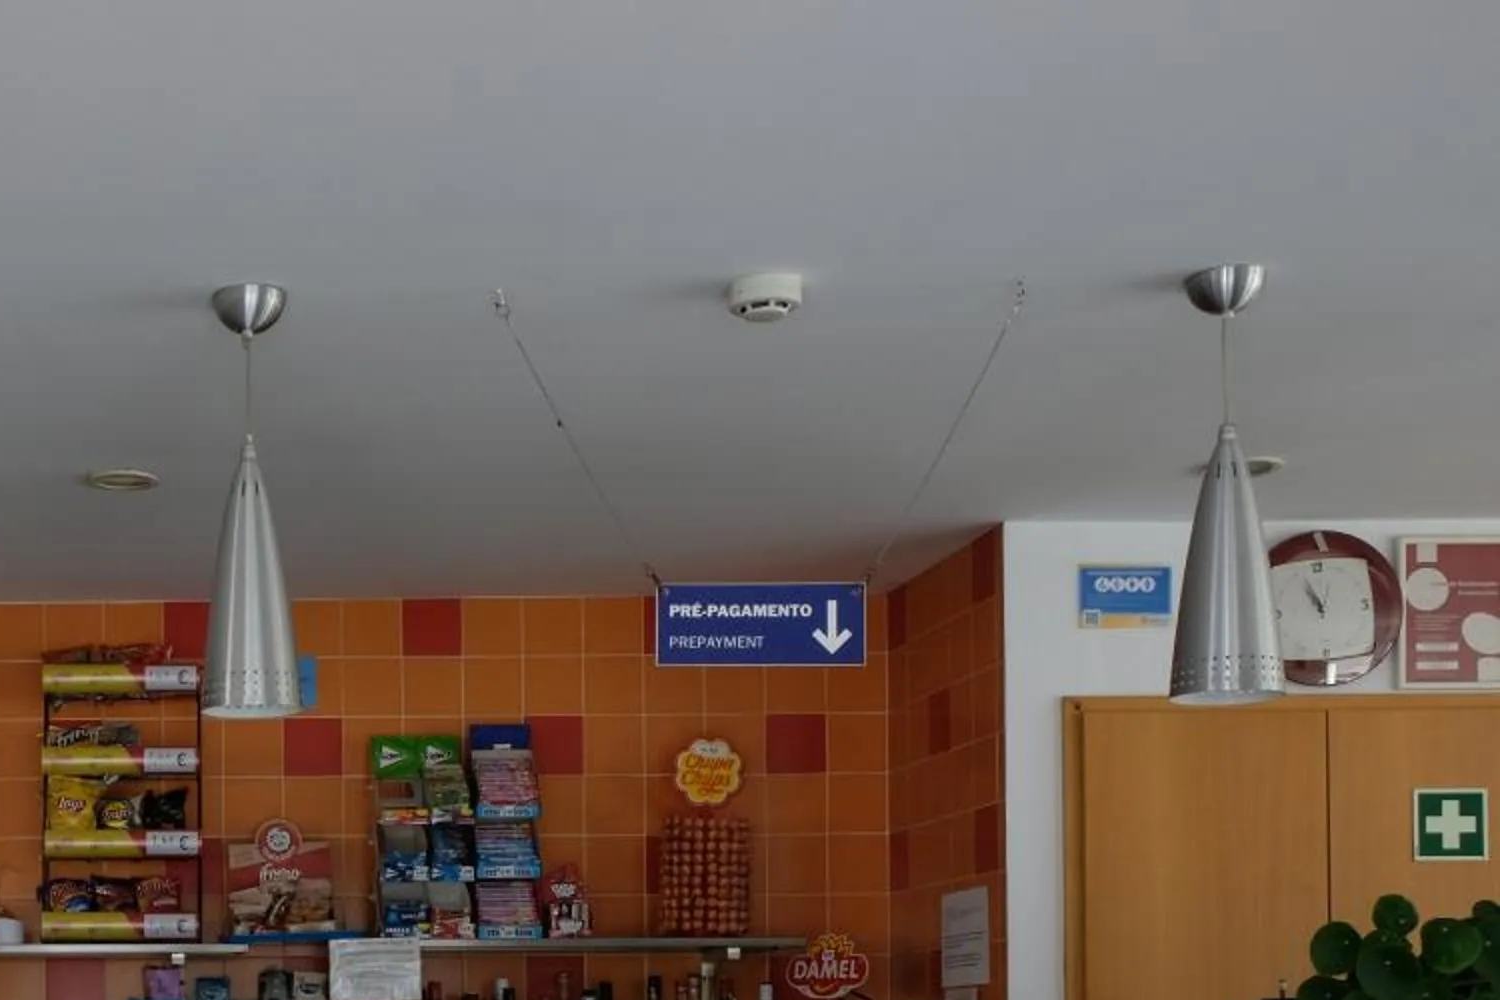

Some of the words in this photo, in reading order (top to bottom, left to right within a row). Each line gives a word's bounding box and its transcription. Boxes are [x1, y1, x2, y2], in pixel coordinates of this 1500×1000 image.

[669, 601, 813, 618] PRÉ-PAGAMENTO
[669, 635, 765, 650] PREPAYMENT
[794, 960, 860, 980] DAMEL
